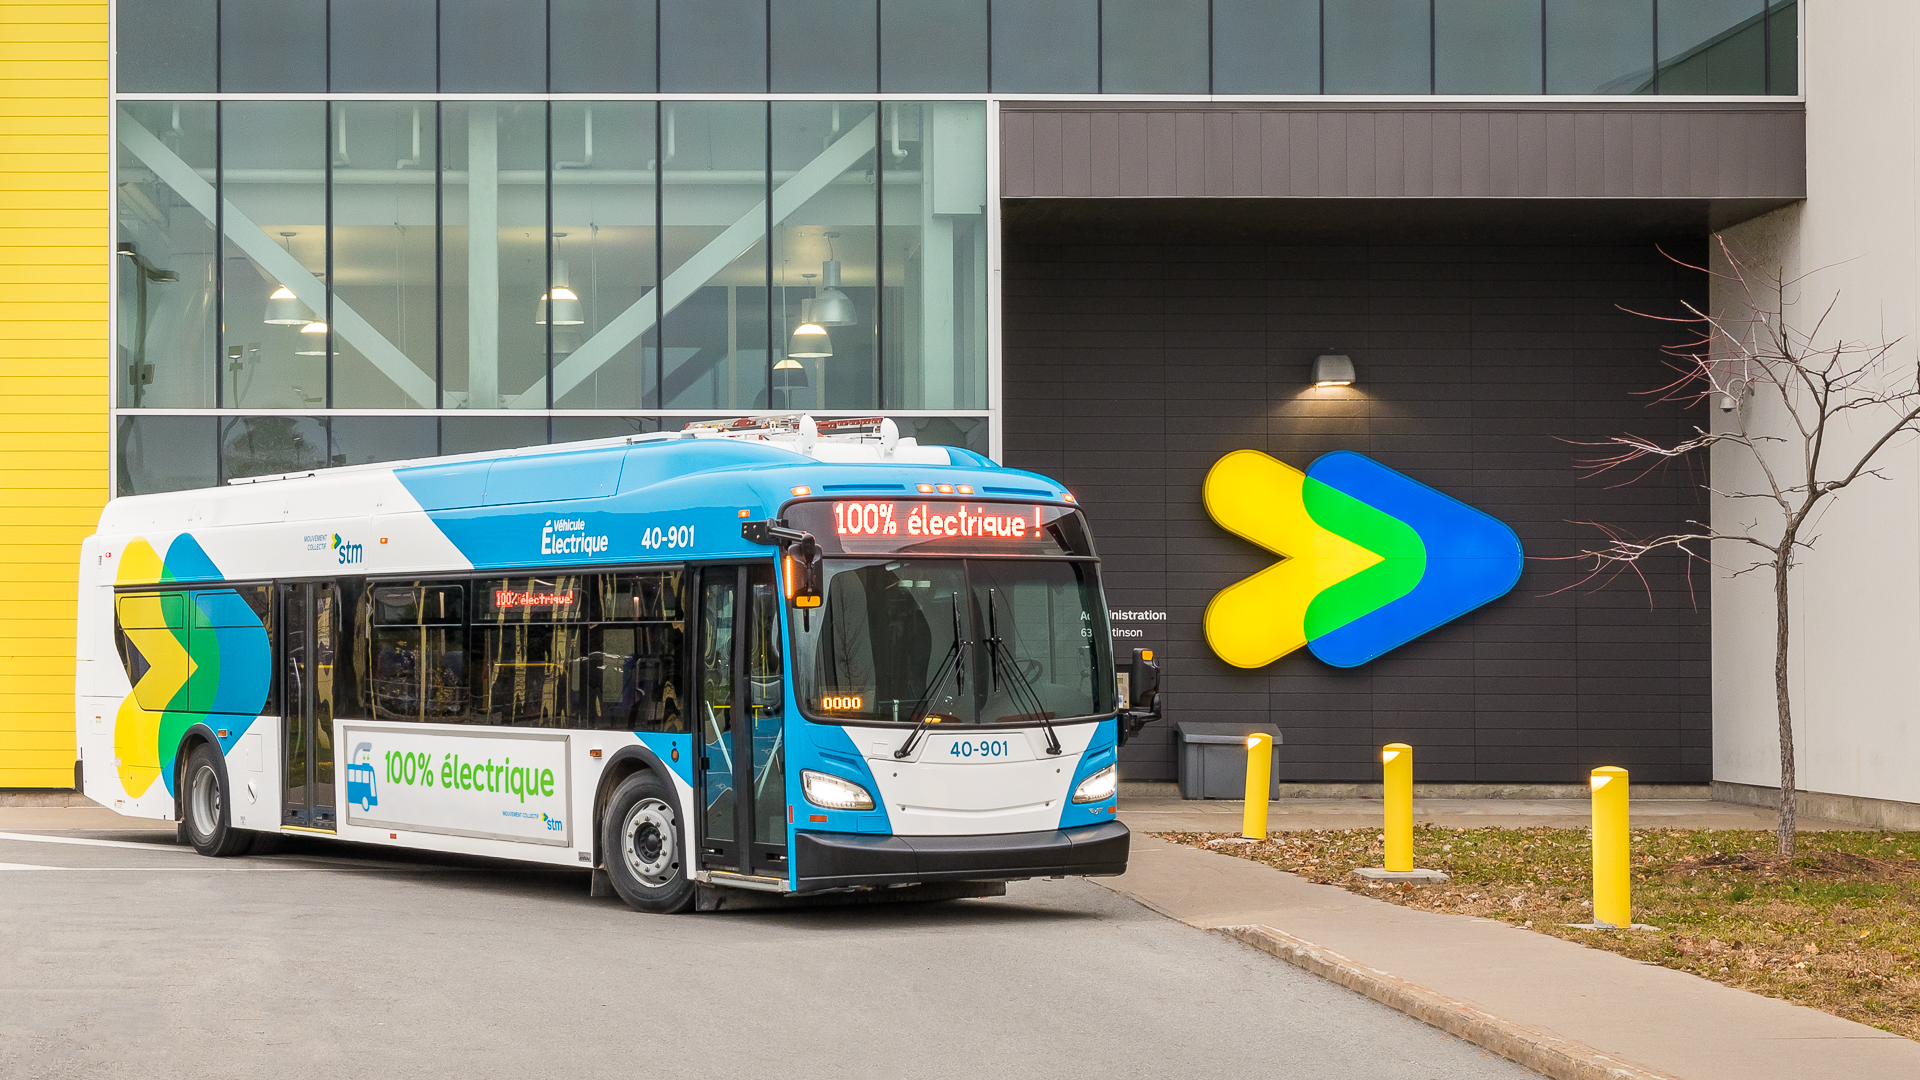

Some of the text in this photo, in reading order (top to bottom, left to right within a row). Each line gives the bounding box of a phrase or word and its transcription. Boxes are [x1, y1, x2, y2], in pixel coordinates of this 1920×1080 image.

[553, 518, 585, 532] Véhicule
[835, 501, 897, 535] 100%
[907, 504, 1026, 537] électrique
[304, 534, 328, 543] MOUVEMENT
[541, 520, 608, 557] Électrique
[641, 525, 695, 549] 40-901
[307, 543, 328, 551] COLLECTIF
[338, 540, 363, 564] stm
[496, 591, 518, 606] 100%
[1080, 609, 1167, 621] Ainistration
[1109, 628, 1143, 638] tinson
[823, 697, 861, 709] 0000
[950, 741, 1008, 757] 40-901
[385, 750, 555, 803] 100% électrique
[547, 818, 563, 831] stm
